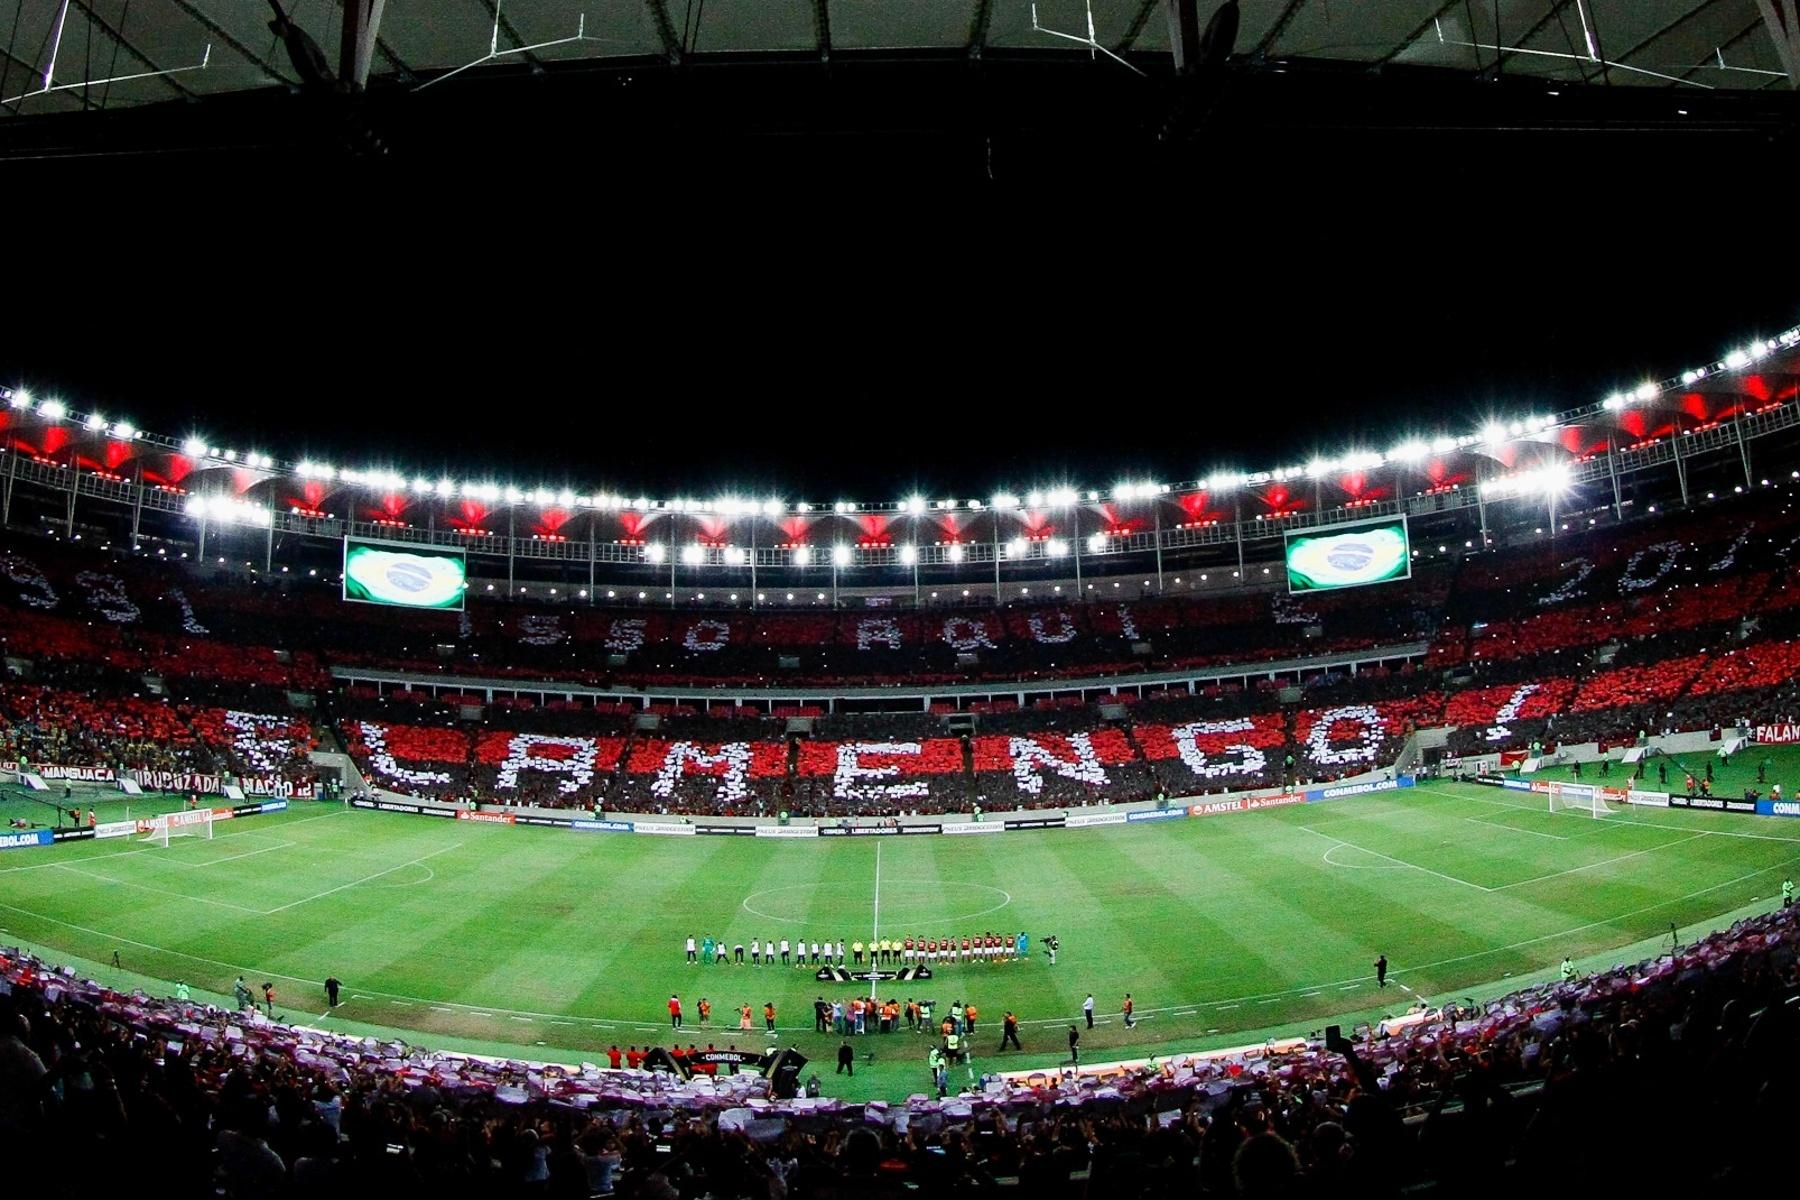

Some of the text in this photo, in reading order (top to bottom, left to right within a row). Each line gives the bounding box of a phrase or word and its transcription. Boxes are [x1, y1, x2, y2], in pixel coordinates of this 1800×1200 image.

[1323, 780, 1398, 798] CONMEBOL.COM
[1260, 794, 1302, 807] Santander
[1204, 801, 1243, 814] AMSTEL
[470, 813, 512, 823] Santander
[705, 1053, 743, 1062] CONMEBOL
